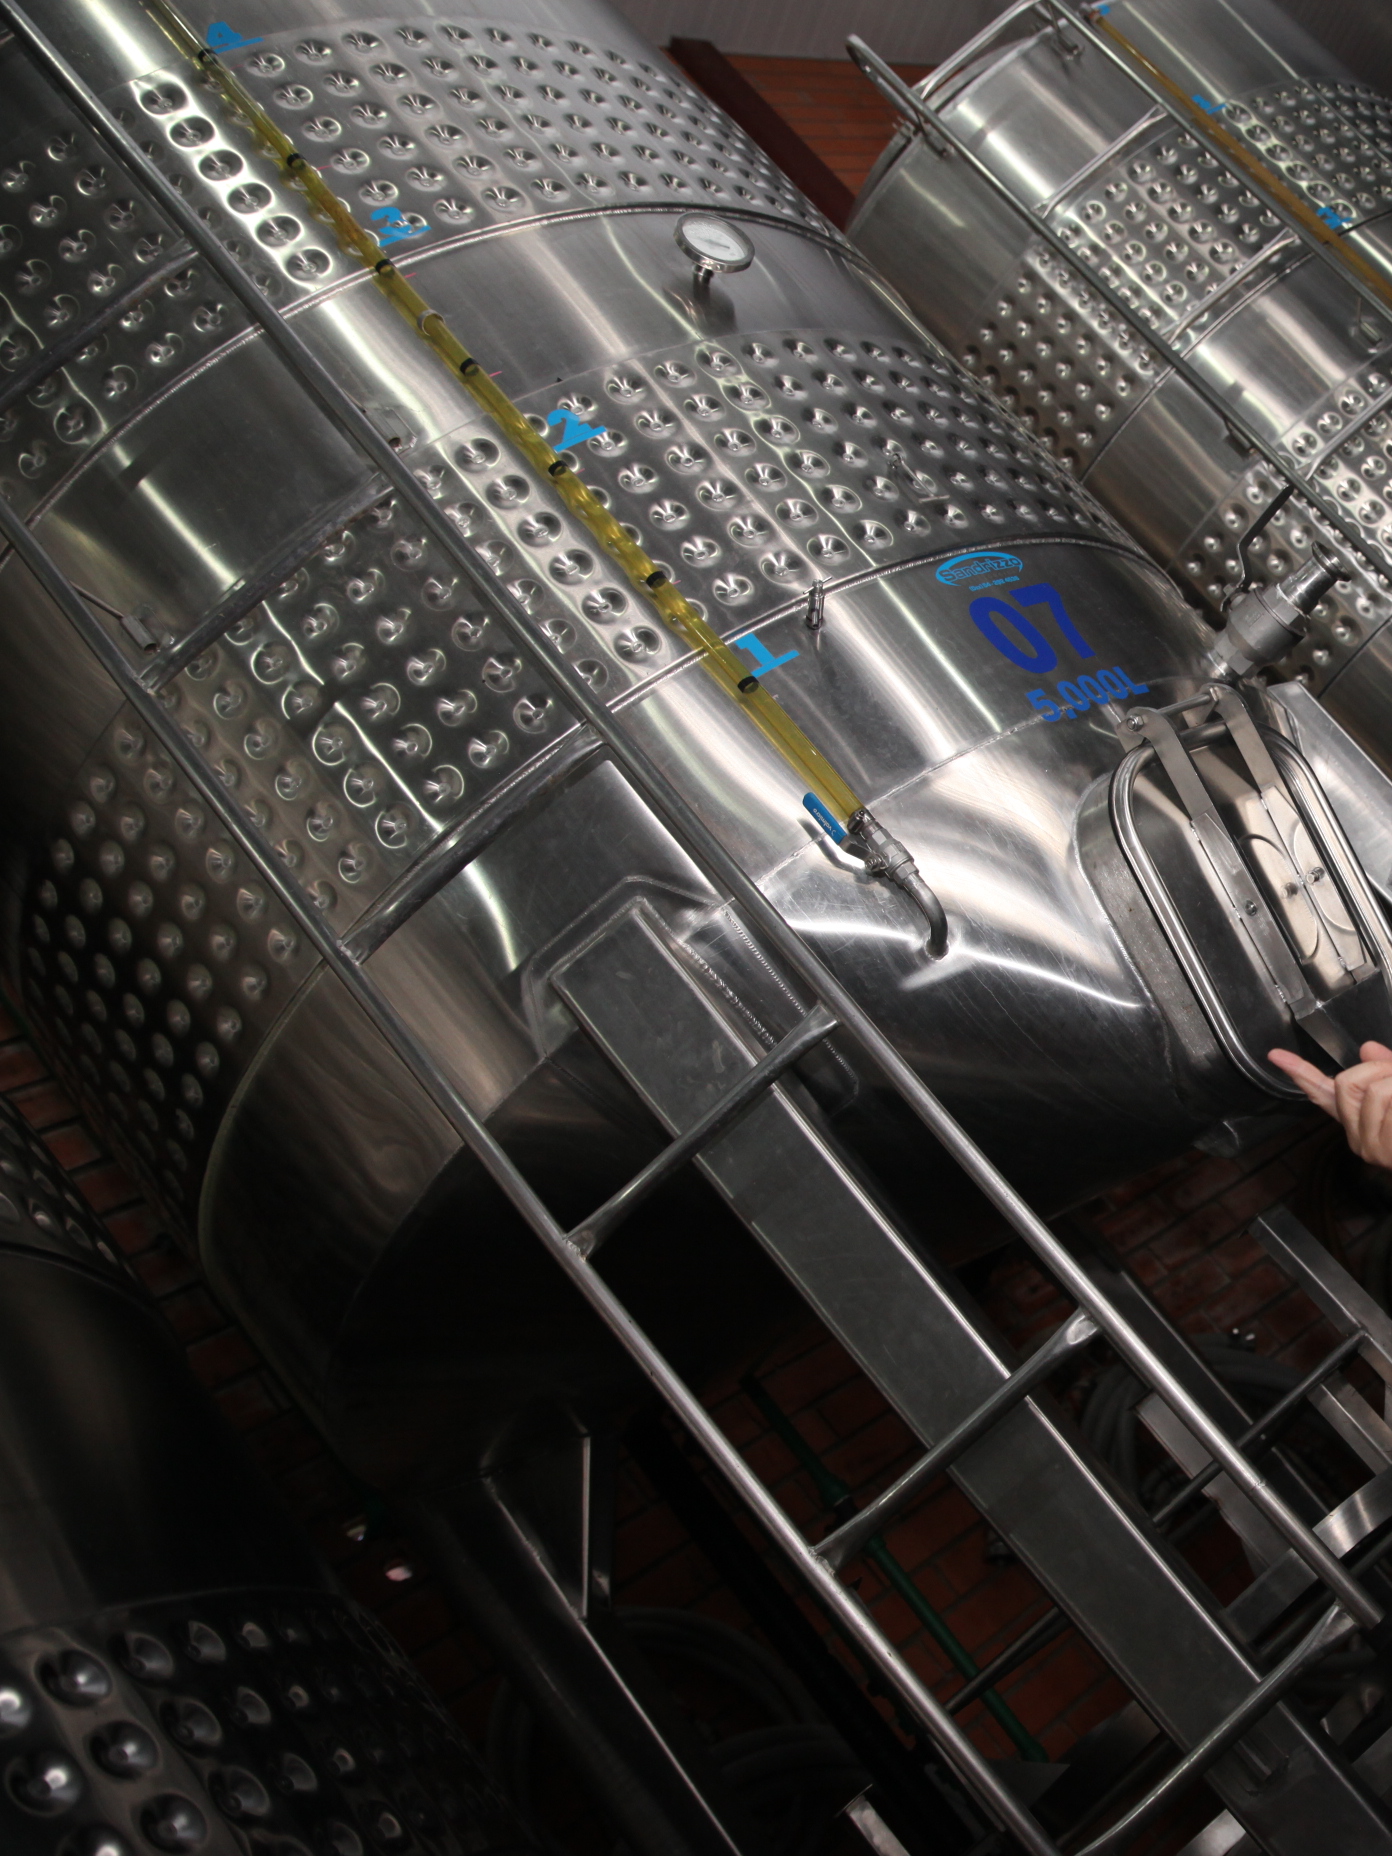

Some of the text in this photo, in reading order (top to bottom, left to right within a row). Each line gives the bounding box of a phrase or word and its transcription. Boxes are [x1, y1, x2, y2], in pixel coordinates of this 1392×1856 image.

[206, 21, 250, 50] 4
[371, 207, 420, 241] 3
[547, 409, 602, 450] 2
[939, 558, 1021, 582] Sandrizzo
[969, 583, 1096, 673] 07
[735, 633, 799, 678] 1
[1025, 666, 1150, 722] 5.000L
